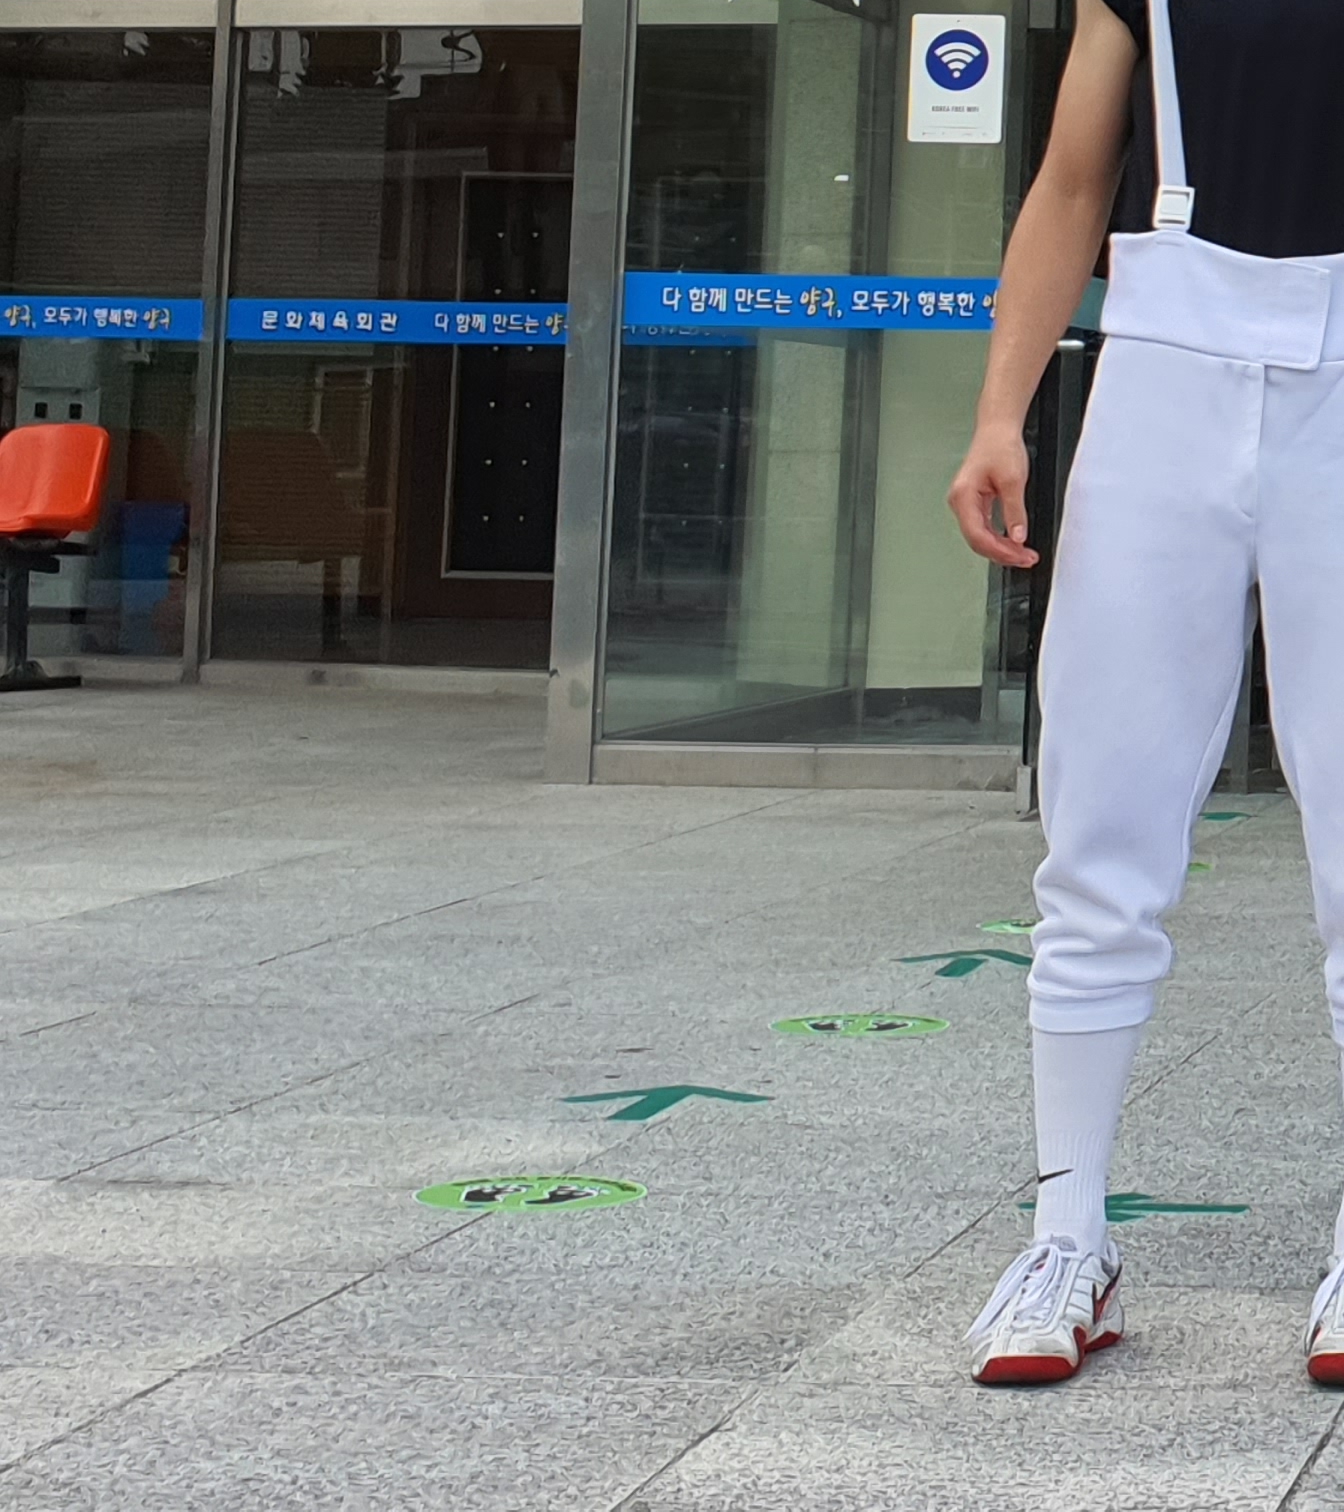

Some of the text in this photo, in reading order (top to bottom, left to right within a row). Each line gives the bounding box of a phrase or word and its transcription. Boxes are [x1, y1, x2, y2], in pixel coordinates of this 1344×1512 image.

[734, 287, 793, 314] 만드는
[851, 290, 910, 316] 모두가
[917, 291, 976, 318] 행복한
[492, 314, 540, 334] 만드는
